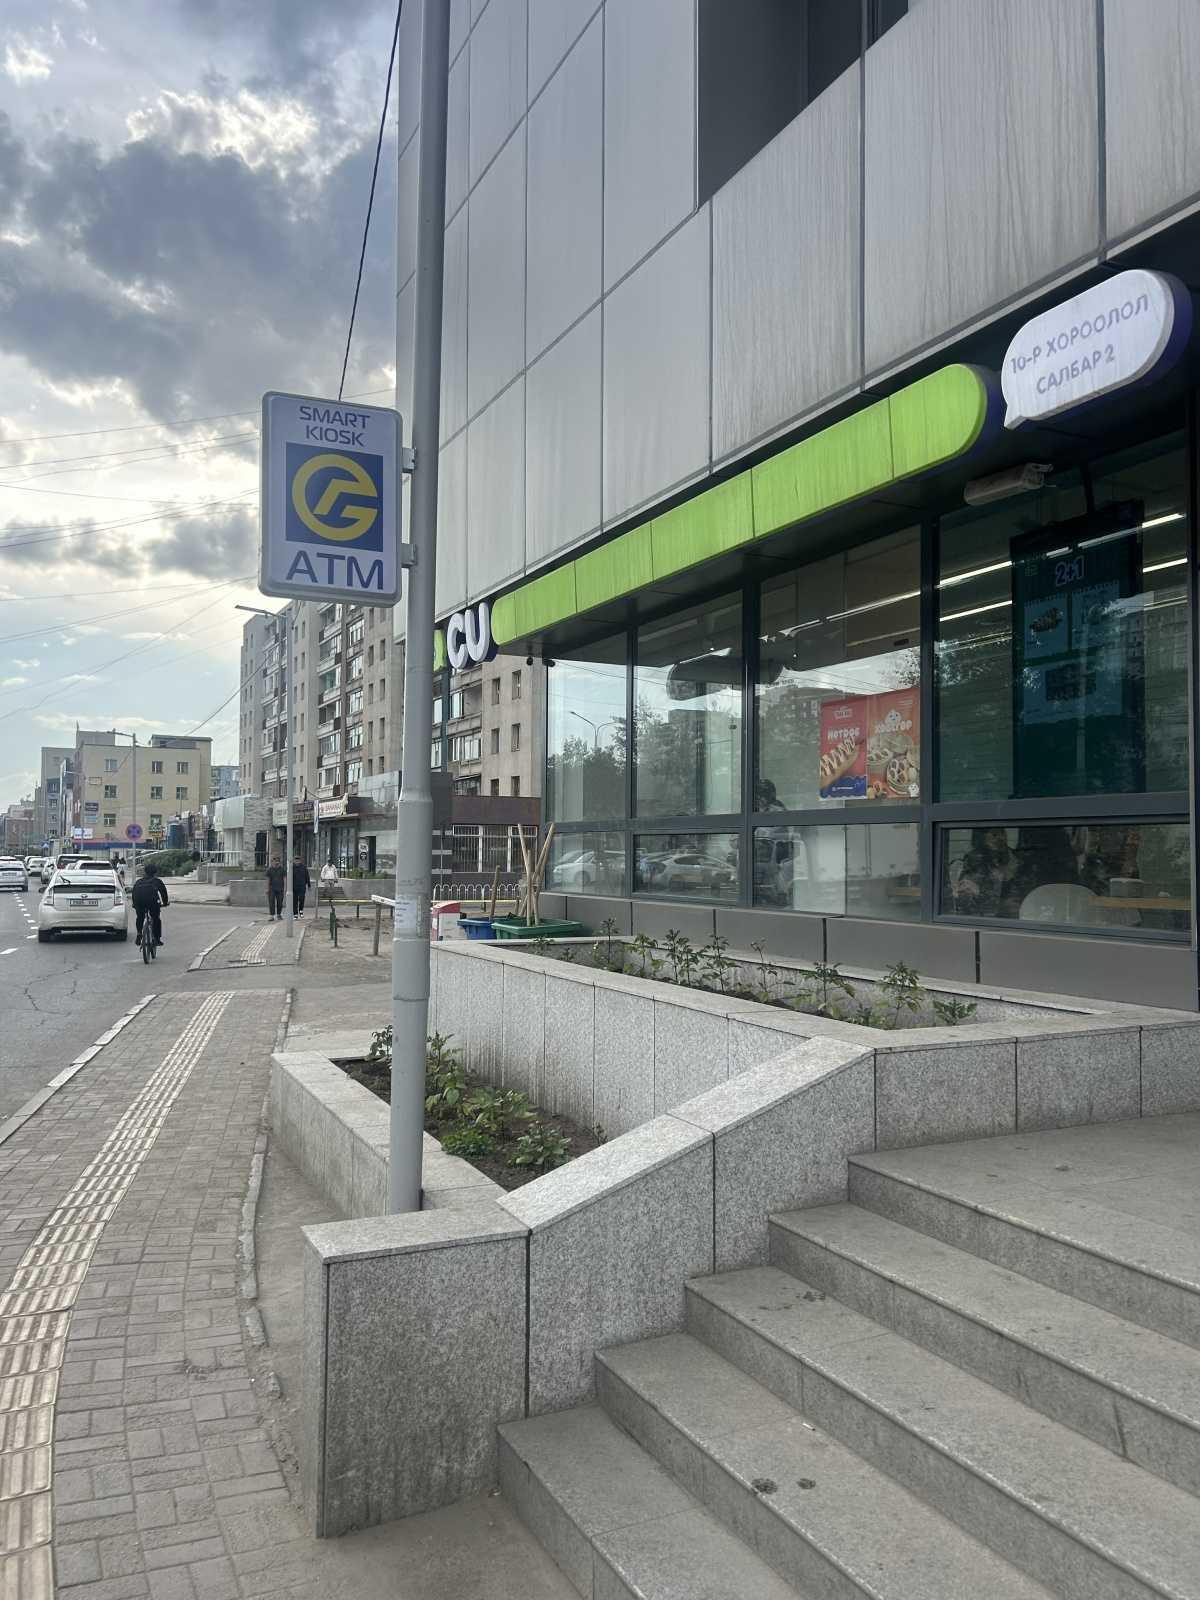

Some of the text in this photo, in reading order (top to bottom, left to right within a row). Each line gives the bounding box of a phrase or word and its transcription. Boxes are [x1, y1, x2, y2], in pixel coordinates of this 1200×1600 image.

[1046, 293, 1149, 357] ХОРООЛОЛ
[1036, 343, 1116, 394] САЛБАР 2
[299, 405, 370, 429] SMART
[306, 425, 365, 447] KIOSK
[285, 549, 384, 590] ATM
[447, 602, 491, 669] CU
